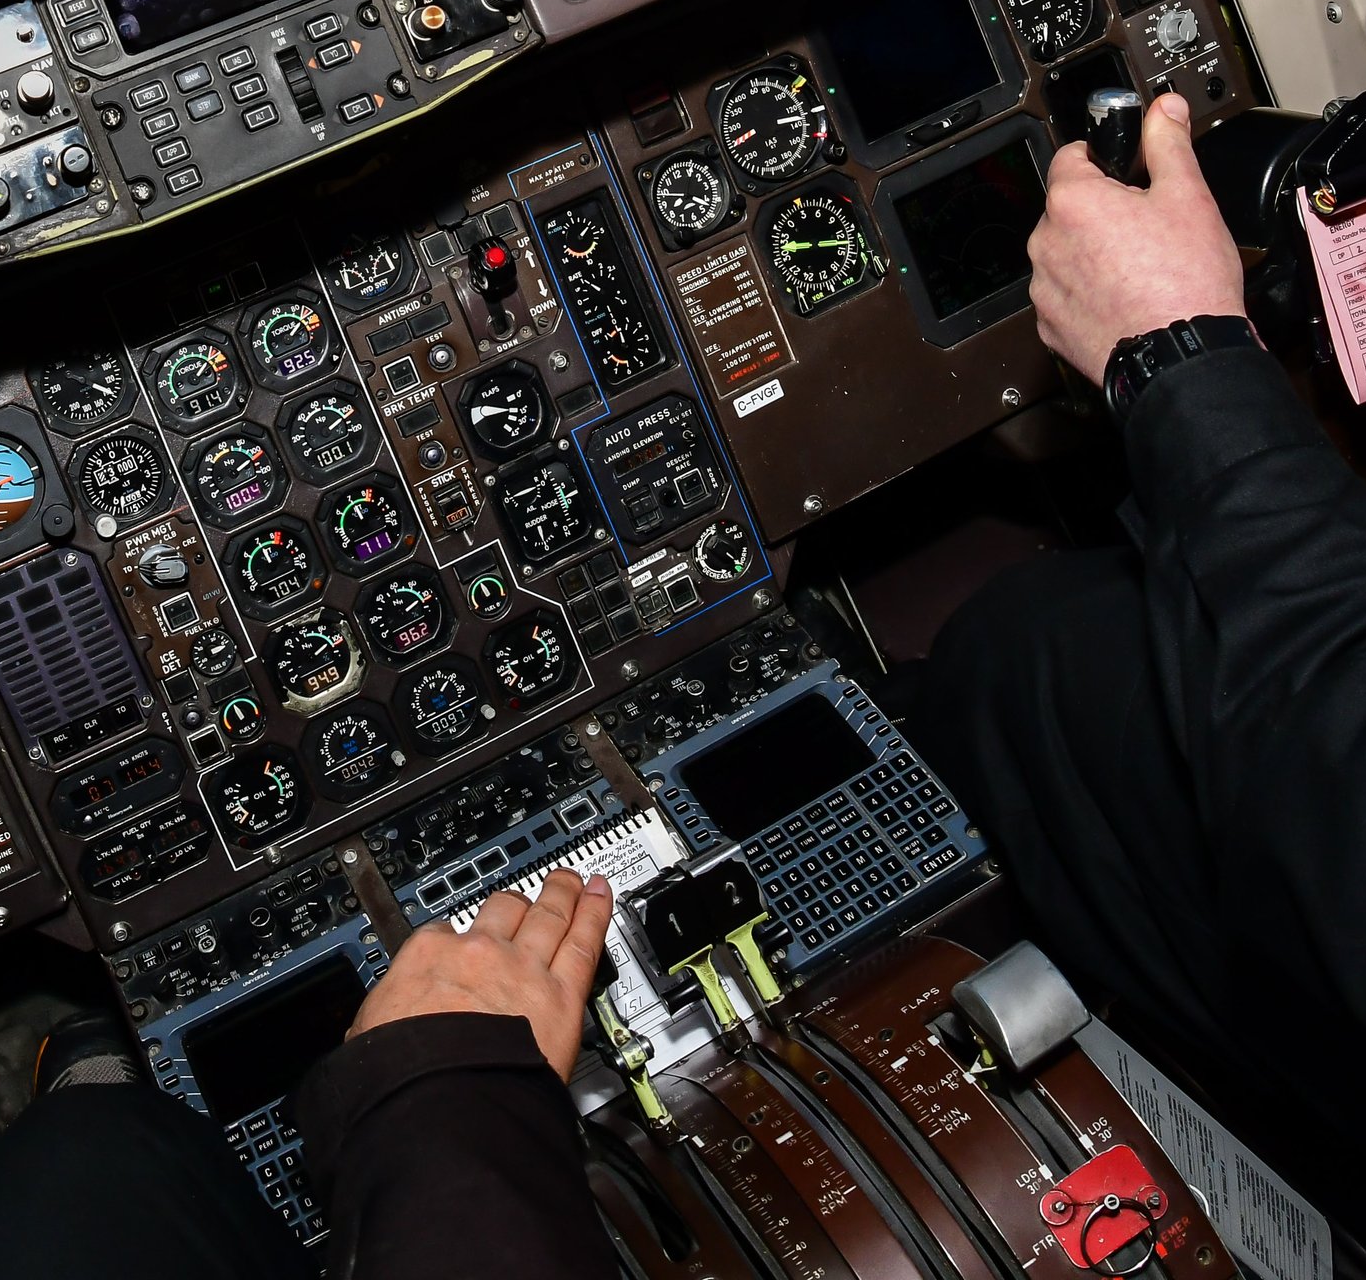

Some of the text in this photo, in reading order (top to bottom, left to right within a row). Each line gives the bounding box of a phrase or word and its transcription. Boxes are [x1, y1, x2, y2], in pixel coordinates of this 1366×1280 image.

[68, 0, 87, 12] RESET
[185, 72, 201, 83] BANK
[143, 90, 155, 101] HDG
[198, 100, 211, 111] STBY
[352, 103, 364, 113] CPL
[155, 120, 167, 129] NAV
[255, 112, 266, 122] ALT
[166, 147, 178, 157] APP
[517, 237, 530, 248] UP
[676, 246, 747, 283] SPEED LIMITS (IAS)
[378, 301, 421, 326] ANTISKID
[529, 298, 557, 317] DOWN
[705, 306, 743, 327] RETRACTING
[425, 332, 443, 344] TEST
[282, 351, 316, 374] 92.5
[189, 389, 224, 414] 91.4
[383, 387, 436, 417] BRK TEMP
[738, 383, 779, 411] C-FVGF
[605, 408, 670, 446] AUTO PRESS
[416, 430, 434, 441] TEST
[604, 431, 664, 464] LANDING ELEVATION
[431, 471, 456, 488] STICK
[622, 478, 640, 491] DUMP
[652, 476, 668, 488] TEST
[525, 514, 548, 528] RUDDER
[125, 522, 172, 549] PWR MGT
[182, 537, 197, 548] CRZ
[271, 578, 300, 599] 704
[398, 623, 429, 648] 96.2
[160, 650, 177, 664] ICE
[162, 659, 181, 674] DET
[307, 667, 340, 691] 94.9
[84, 719, 98, 730] CLR
[53, 734, 68, 744] RCL
[841, 811, 857, 823] NEXT
[924, 850, 955, 872] ENTER
[901, 988, 939, 1015] FLAPS
[1086, 1117, 1108, 1136] LDG
[1015, 1168, 1037, 1188] LDG
[1160, 1217, 1190, 1244] EMER
